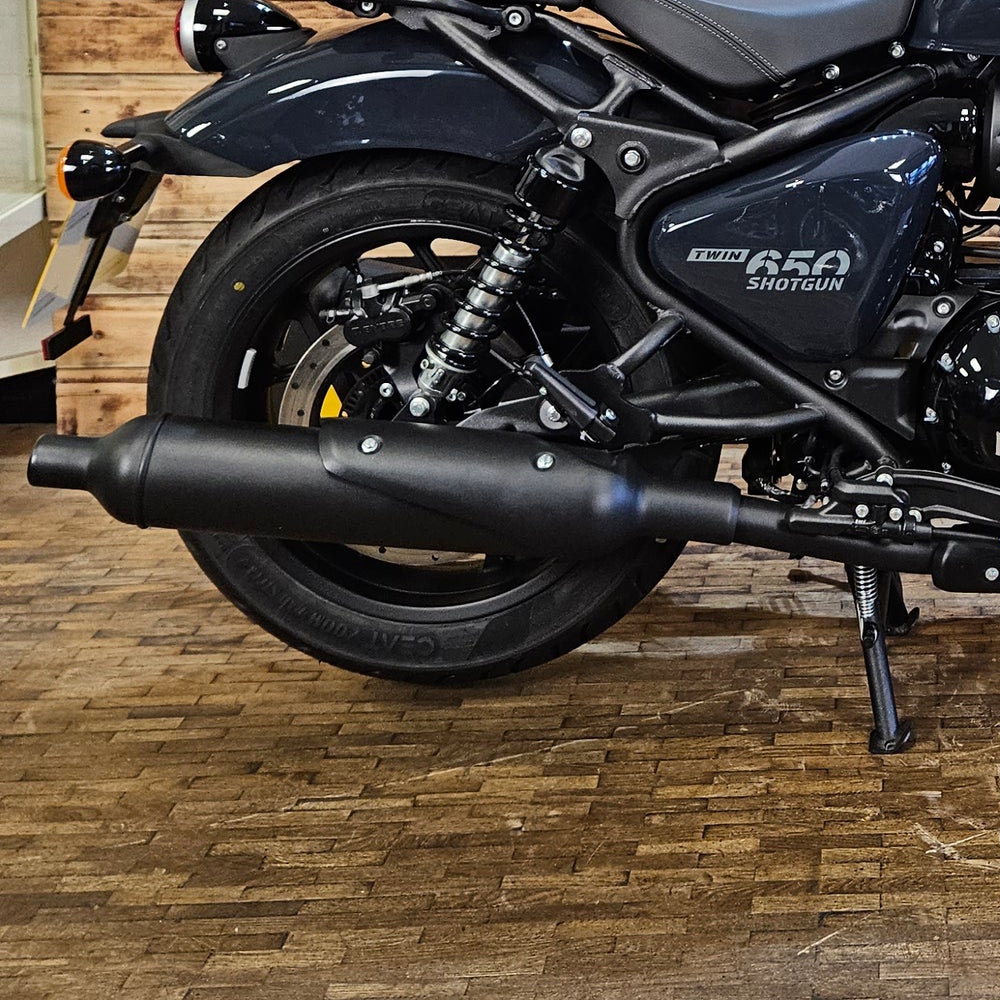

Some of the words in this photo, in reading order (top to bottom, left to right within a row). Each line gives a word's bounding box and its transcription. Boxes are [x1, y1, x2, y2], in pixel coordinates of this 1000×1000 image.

[694, 250, 742, 261] TWIN
[745, 249, 851, 276] 650
[746, 276, 845, 292] SHOTGUN
